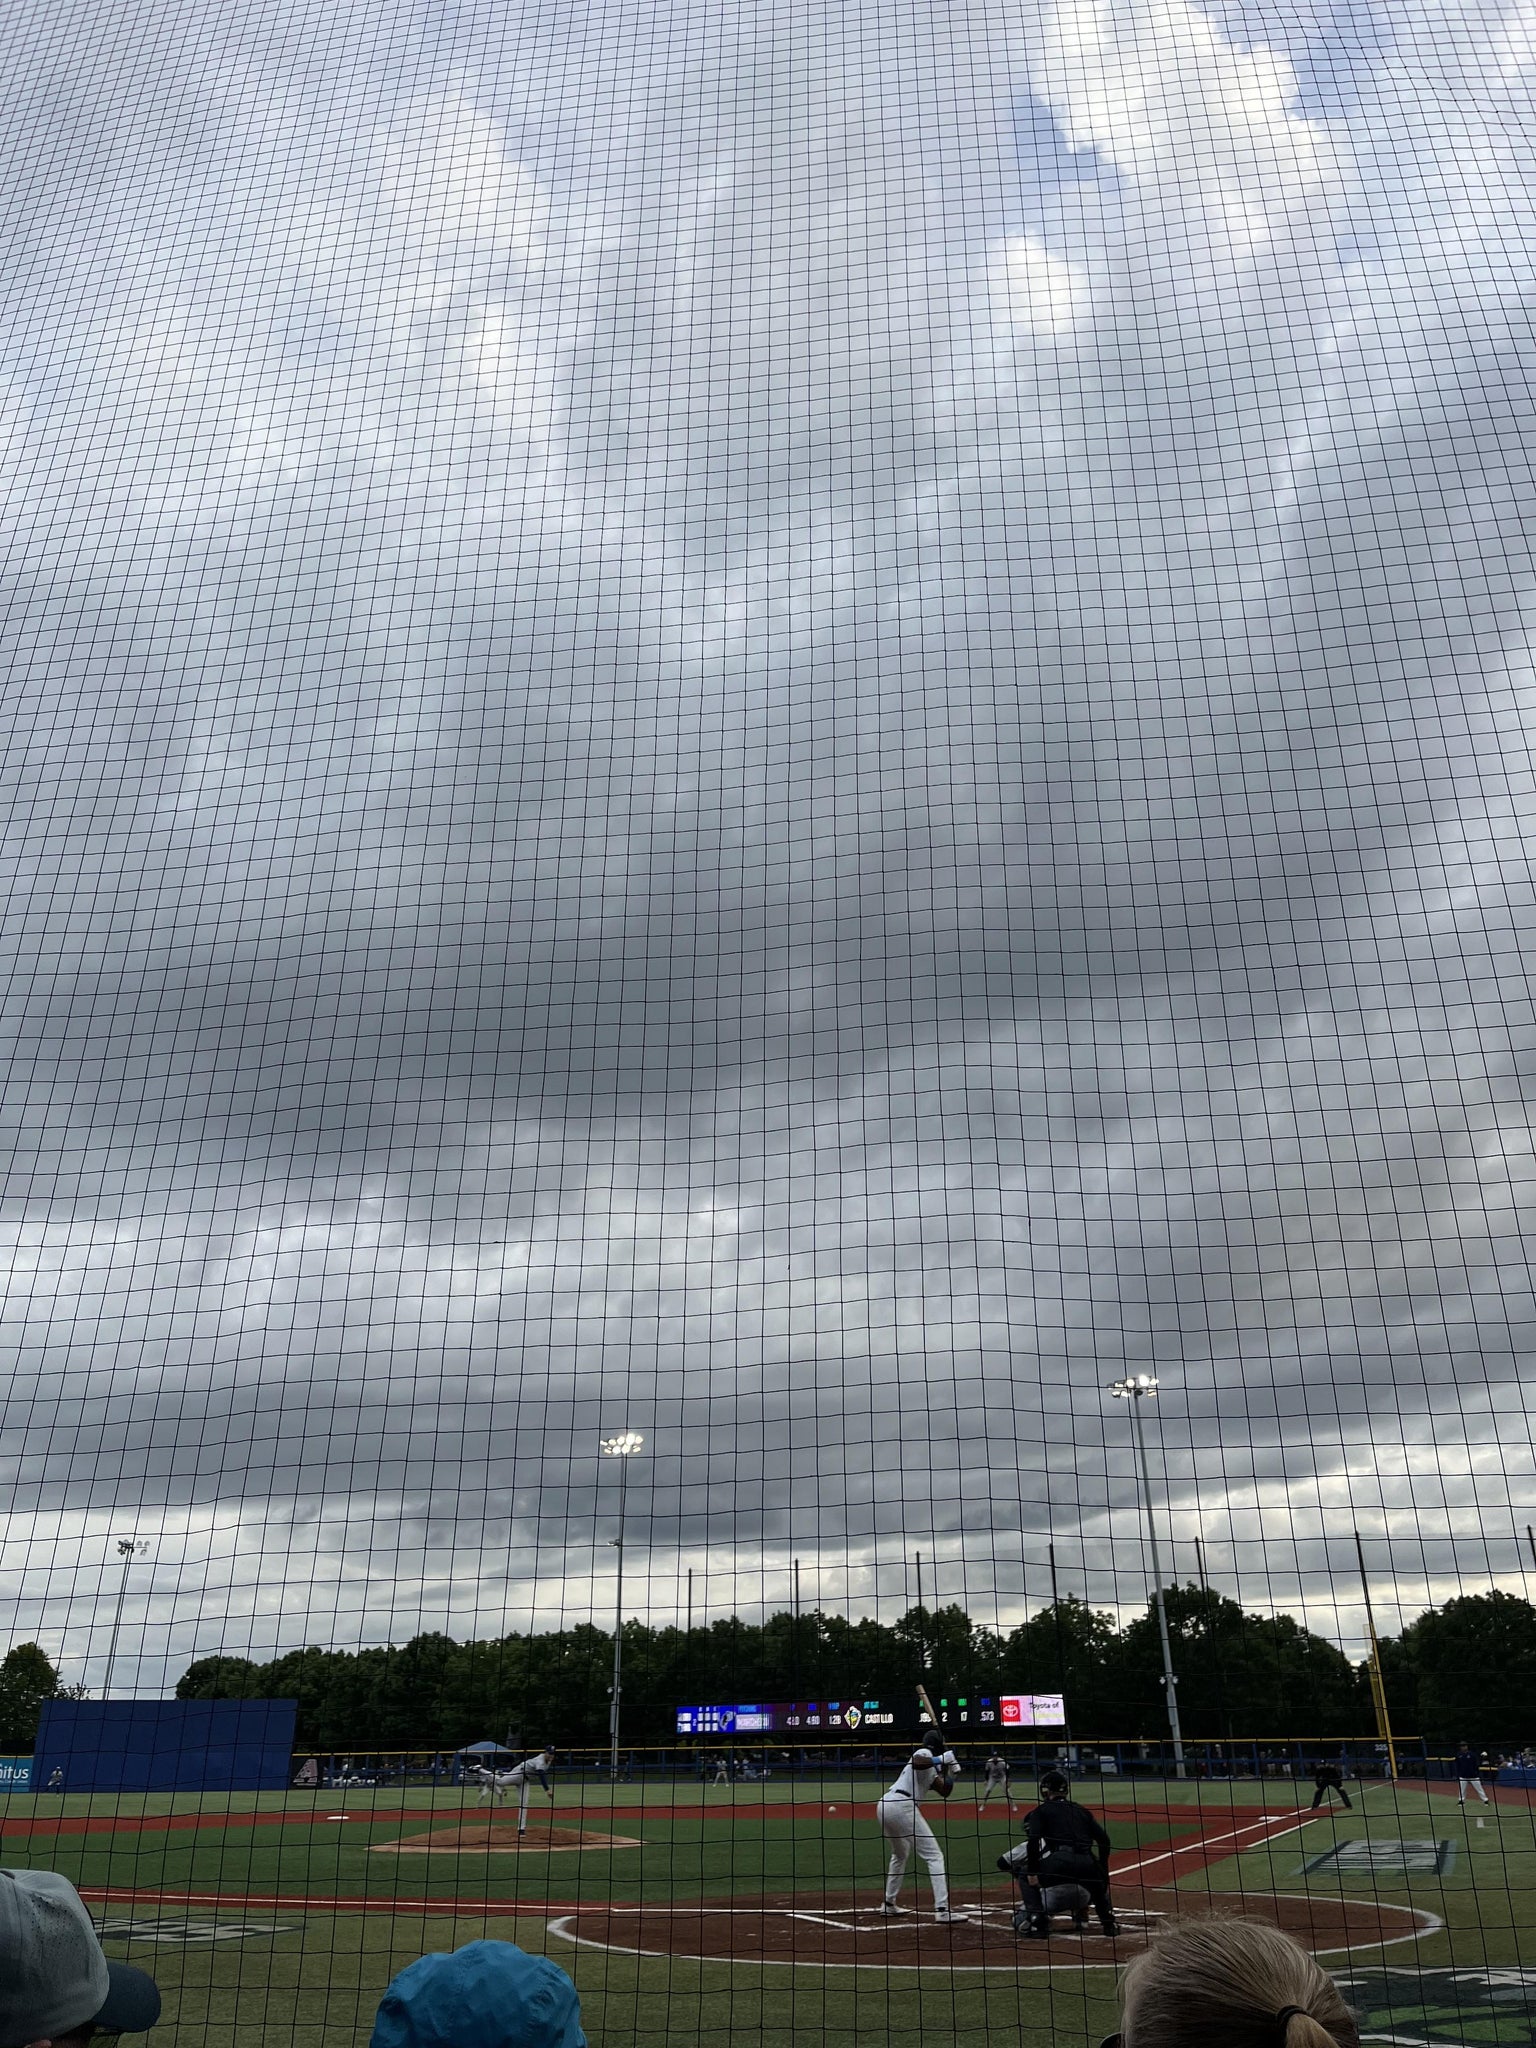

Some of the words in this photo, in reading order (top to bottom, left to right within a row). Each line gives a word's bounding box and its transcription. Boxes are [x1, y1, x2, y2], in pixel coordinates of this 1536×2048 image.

[1029, 1702, 1050, 1710] Toyota
[1052, 1701, 1059, 1709] of
[942, 1712, 948, 1722] 2
